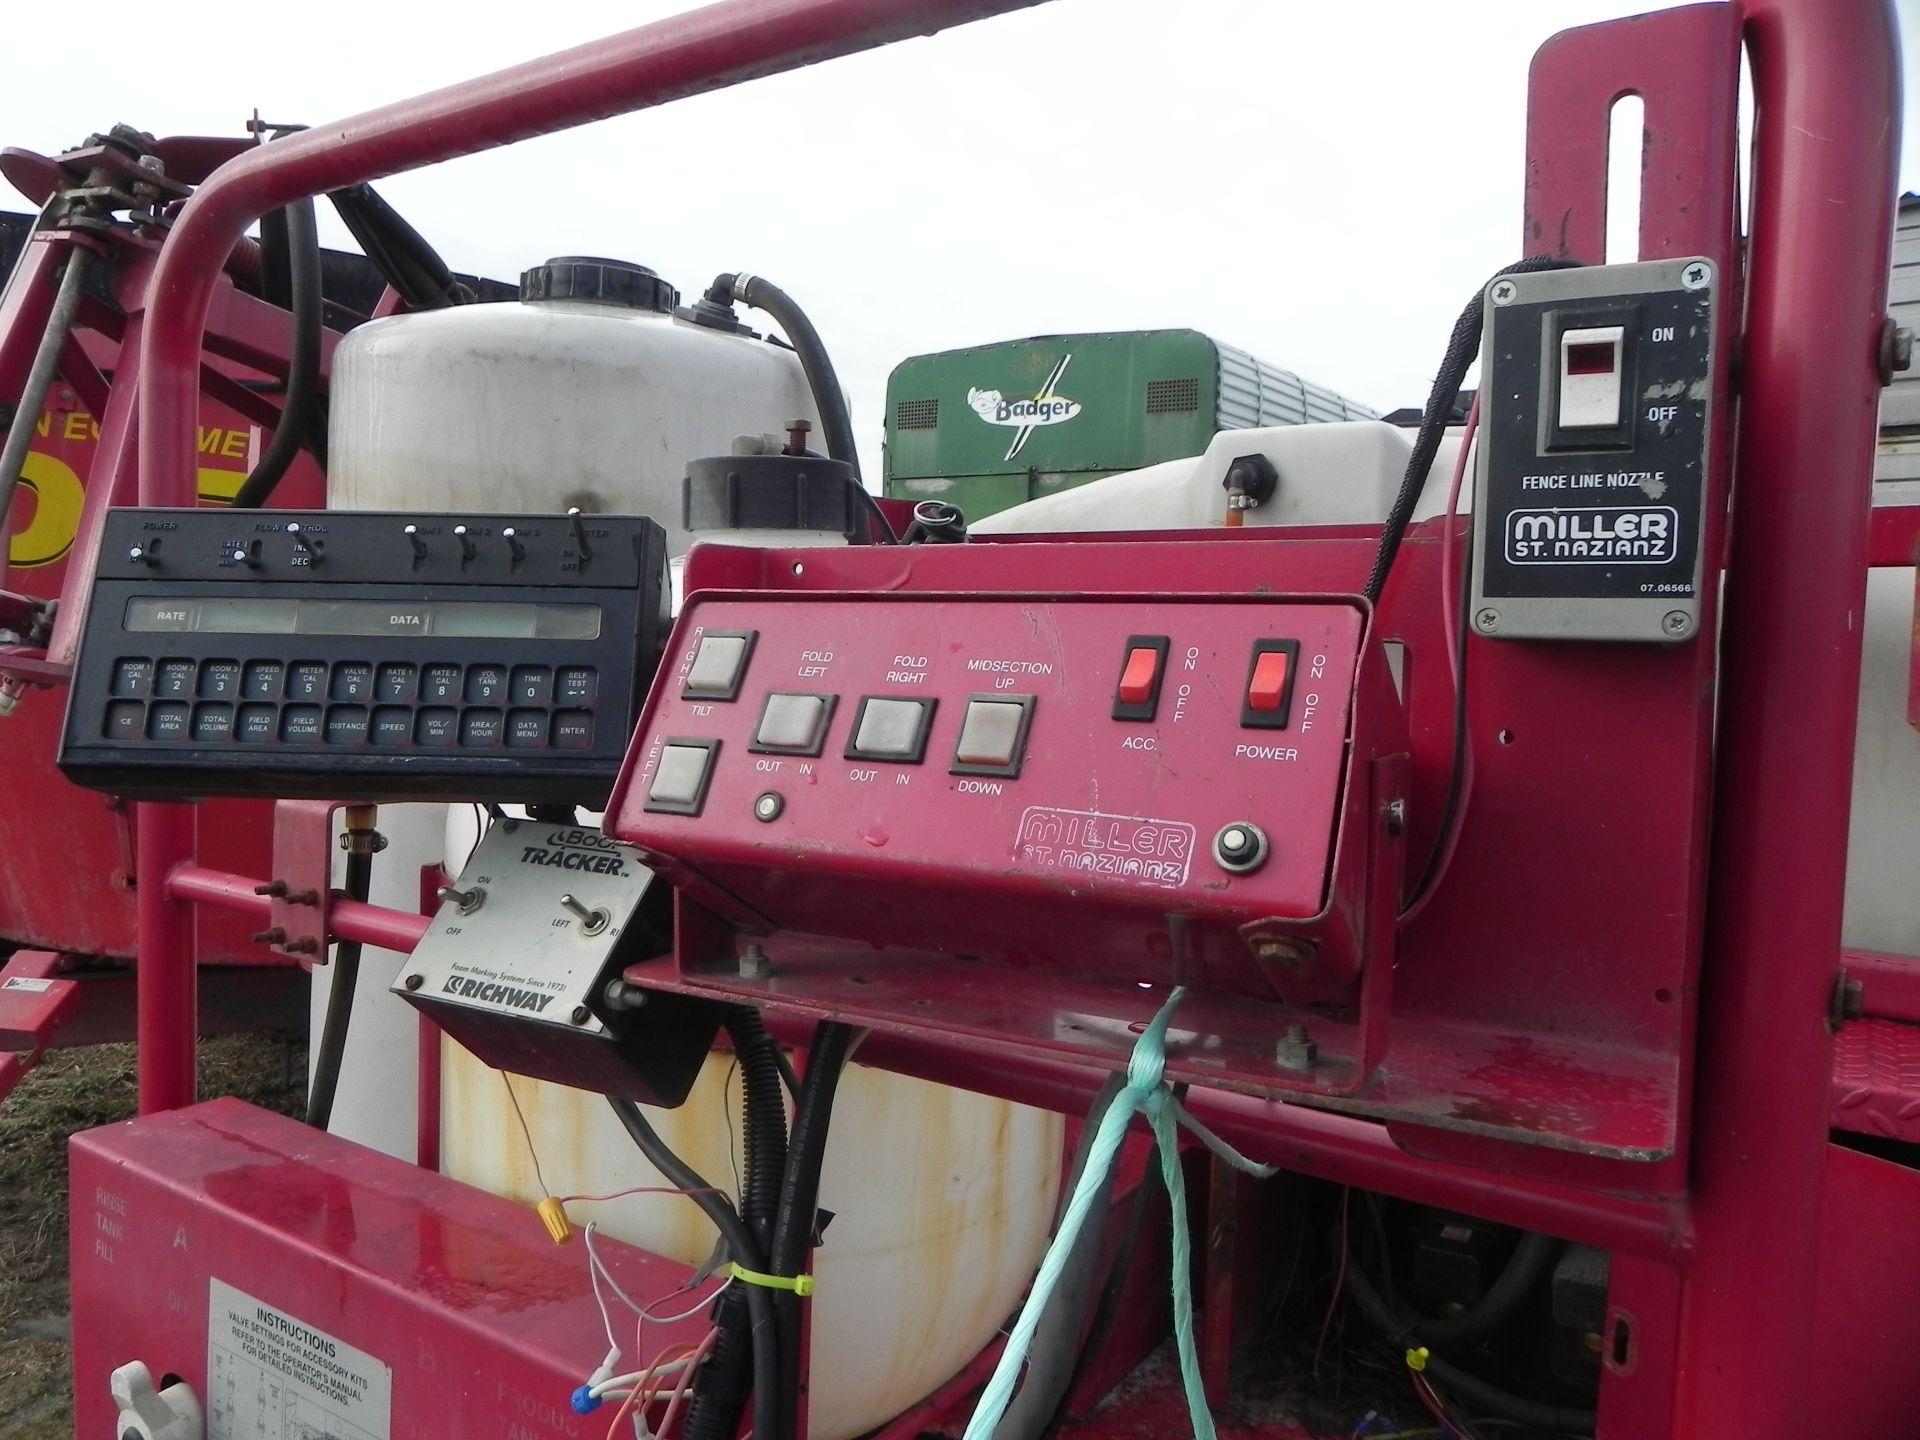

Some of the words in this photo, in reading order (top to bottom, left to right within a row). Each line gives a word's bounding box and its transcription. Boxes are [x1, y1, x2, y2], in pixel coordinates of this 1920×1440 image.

[1651, 327, 1674, 342] ON
[995, 402, 1073, 422] Badger
[1648, 406, 1678, 421] OFF
[1522, 475, 1567, 489] FENCE
[1570, 474, 1603, 488] LINE
[143, 522, 177, 531] POWER
[255, 524, 280, 532] FLOW
[1514, 513, 1669, 540] MILLER
[1515, 541, 1548, 557] ST.
[1554, 539, 1666, 557] NAZIANZ
[291, 558, 308, 567] DEC
[1640, 583, 1691, 592] 07.06566
[156, 611, 186, 621] RATE
[390, 615, 420, 626] DATA
[677, 627, 703, 685] RIGHT
[801, 651, 833, 662] FOLD
[893, 655, 927, 667] FOLD
[1184, 647, 1199, 670] ON
[798, 667, 827, 677] LEFT
[967, 659, 1053, 675] MIDSECTION
[1310, 654, 1326, 679] ON
[303, 674, 317, 682] CAL
[347, 675, 361, 683] CAL
[481, 670, 496, 678] VOL
[524, 675, 542, 683] TIME
[886, 671, 927, 684] RIGHT
[130, 680, 136, 689] 1
[173, 681, 180, 690] 2
[391, 676, 406, 684] CAL
[436, 677, 450, 685] CAL
[995, 678, 1015, 689] UP
[217, 682, 224, 691] 3
[261, 682, 268, 692] 4
[305, 683, 312, 693] 5
[349, 684, 357, 694] 6
[394, 685, 401, 695] 7
[438, 685, 446, 696] 8
[483, 686, 491, 697] 9
[527, 687, 535, 698] 0
[1173, 684, 1191, 722] OFF
[691, 705, 714, 717] TILT
[1301, 693, 1319, 733] OFF
[249, 716, 270, 724] FIELD
[293, 717, 315, 725] FIELD
[427, 720, 450, 728] VOL/
[470, 721, 497, 729] AREA/
[200, 723, 229, 731] VOLUME
[248, 724, 268, 732] AREA
[287, 725, 318, 733] VOLUME
[329, 722, 367, 730] DISTANCE
[380, 723, 405, 731] SPEED
[517, 722, 538, 730] DATA
[560, 727, 585, 735] ENTER
[429, 728, 444, 736] MIN
[471, 729, 493, 737] HOUR
[516, 730, 538, 738] MENU
[1121, 736, 1157, 750] ACC.
[1235, 744, 1298, 762] POWER
[641, 734, 661, 784] LEFT
[756, 760, 782, 772] OUT
[799, 764, 812, 775] IN
[849, 769, 878, 782] OUT
[895, 774, 910, 785] IN
[958, 780, 1002, 796] DOWN
[1024, 813, 1188, 859] MILLER
[521, 846, 624, 876] TRACKER
[1059, 849, 1182, 882] NAZIANZ
[477, 875, 491, 885] ON
[552, 918, 570, 929] LEFT
[446, 927, 461, 936] OFF
[451, 962, 469, 973] Foam
[470, 966, 498, 980] Marking
[499, 972, 525, 984] Systems
[526, 977, 545, 988] Since
[459, 979, 554, 1012] RICHWAY
[96, 1187, 129, 1217] RINSE
[96, 1211, 122, 1241] TANK
[172, 1222, 189, 1254] A
[95, 1238, 116, 1265] FILL
[257, 1307, 336, 1358] INSTRUCTIONS
[228, 1310, 250, 1328] VALVE
[251, 1321, 285, 1347] SETTINGS
[286, 1340, 301, 1354] FOR
[302, 1348, 349, 1380] ACCESSORY
[350, 1372, 368, 1390] KITS
[231, 1326, 255, 1346] REFER
[256, 1338, 266, 1350] TO
[267, 1345, 281, 1359] THE
[282, 1352, 329, 1384] OPERATOR'S
[330, 1377, 363, 1402] MANUAL
[242, 1342, 257, 1357] FOR
[258, 1350, 292, 1376] DETAILED
[293, 1370, 350, 1407] INSTRUCTIONS.
